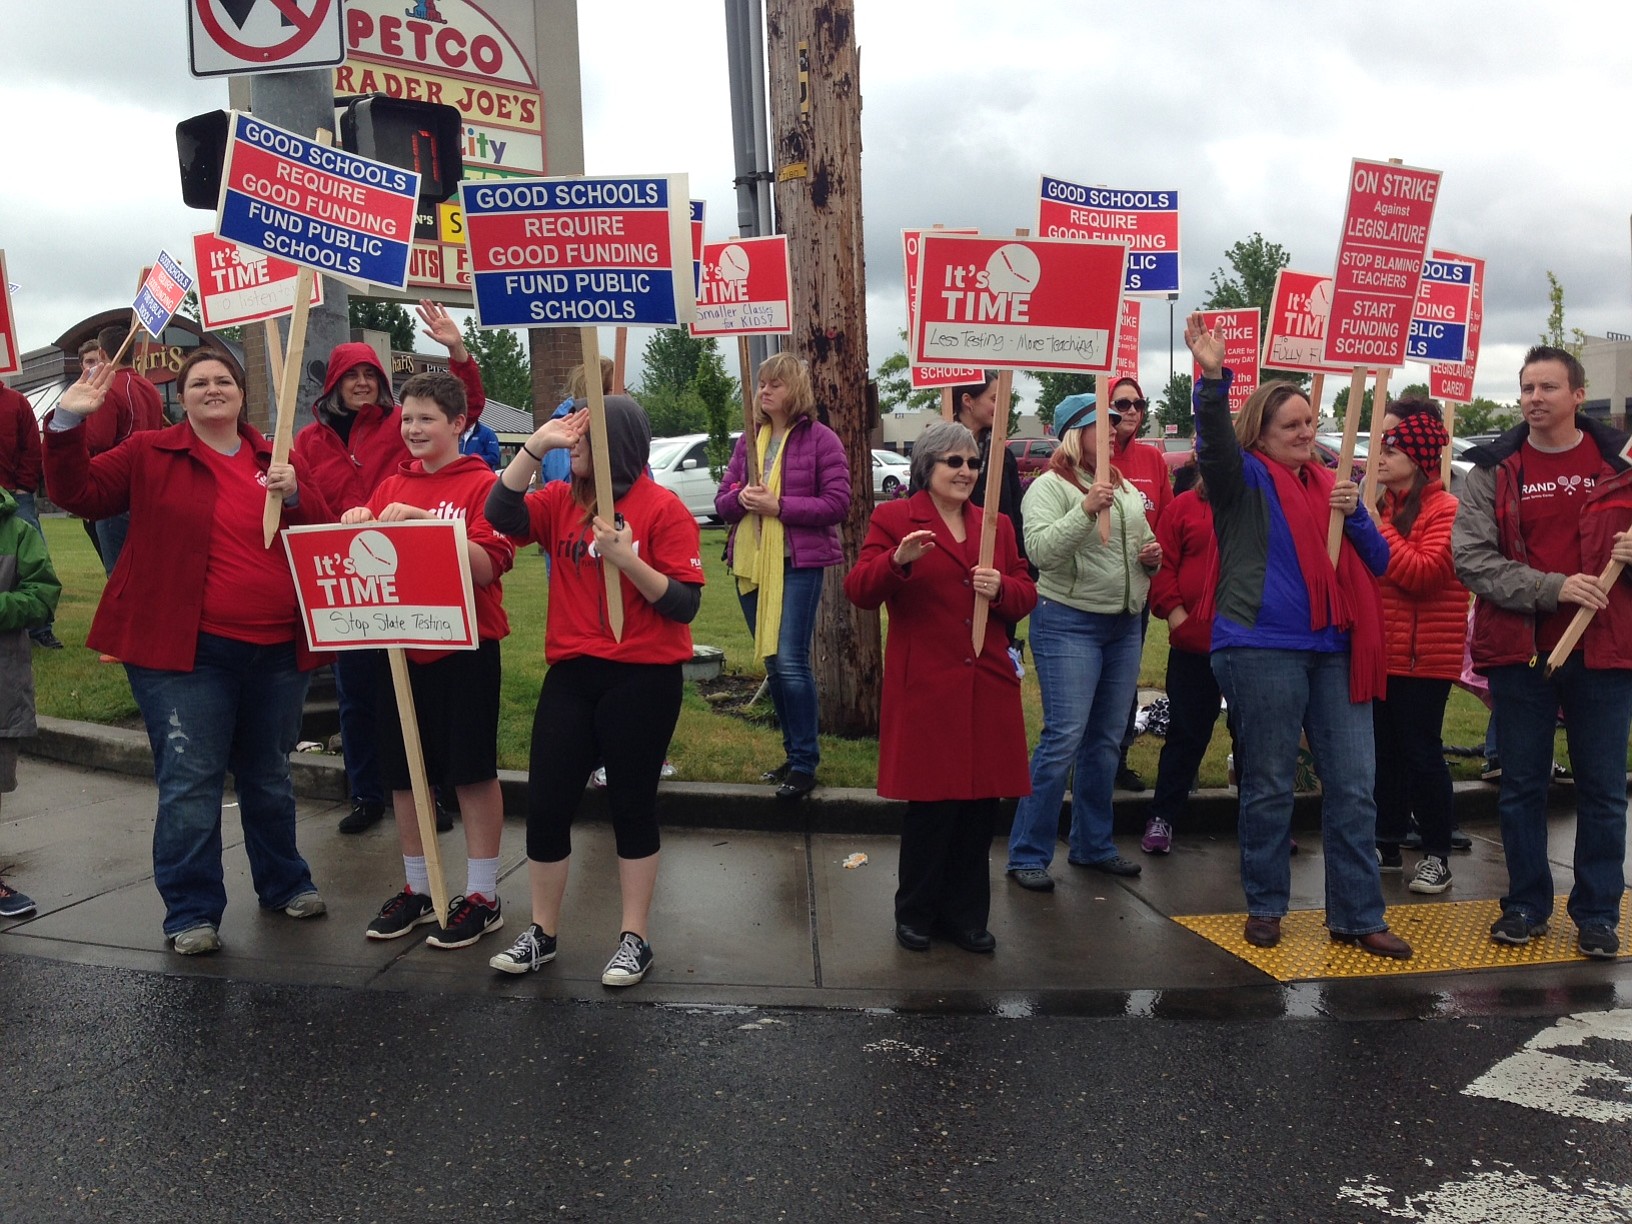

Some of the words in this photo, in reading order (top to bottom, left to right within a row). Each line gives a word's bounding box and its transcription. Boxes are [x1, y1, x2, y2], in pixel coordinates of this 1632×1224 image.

[347, 8, 503, 74] PETCO
[455, 87, 536, 123] JOE'S
[245, 123, 303, 158] GOOD
[308, 147, 406, 191] SCHOOLS
[461, 127, 506, 164] ity
[276, 161, 366, 206] REQUIRE
[1048, 181, 1085, 202] GOOD
[1090, 190, 1169, 208] SCHOOLS
[1354, 169, 1378, 194] ON
[1382, 173, 1436, 203] STRIKE
[242, 173, 300, 207] GOOD
[305, 195, 397, 235] FUNDING
[476, 186, 548, 209] GOOD
[555, 183, 658, 206] SCHOOLS
[1070, 209, 1138, 229] REQUIRE
[1374, 200, 1411, 217] Against
[248, 201, 303, 233] FUND
[308, 222, 383, 256] PUBLIC
[524, 216, 625, 237] REQUIRE
[1347, 216, 1425, 245] LEGISLATURE
[210, 247, 240, 268] It's
[262, 231, 361, 273] SCHOOLS
[488, 245, 559, 266] GOOD
[565, 243, 658, 264] FUNDING
[1127, 255, 1156, 269] LIC
[1341, 251, 1373, 267] STOP
[1374, 255, 1420, 273] BLAMING
[167, 263, 189, 288] SCHOOLS
[211, 259, 270, 292] TIME
[505, 274, 569, 295] FUND
[575, 273, 650, 293] PUBLIC
[945, 264, 990, 288] It's
[1352, 269, 1407, 289] TEACHERS
[700, 279, 749, 303] TIME
[1287, 292, 1312, 312] It's
[530, 299, 636, 320] SCHOOLS
[696, 305, 736, 320] Smaller
[743, 304, 773, 315] Classes
[941, 290, 1032, 323] TIME
[1353, 300, 1396, 319] START
[1416, 302, 1456, 319] DING
[740, 314, 773, 328] KIDS?
[1215, 315, 1237, 327] ON
[1340, 318, 1399, 338] FUNDING
[930, 328, 959, 347] Less
[961, 330, 1004, 351] Testing
[1017, 333, 1045, 351] More
[1227, 347, 1246, 355] CARE
[1246, 347, 1255, 355] for
[1335, 337, 1398, 357] SCHOOLS
[920, 367, 975, 380] SCHOOLS
[1238, 373, 1252, 382] the
[1441, 379, 1466, 396] CARED!
[313, 552, 357, 576] It's
[316, 575, 400, 606] TIME
[330, 611, 369, 637] Stop
[373, 612, 406, 631] State
[412, 613, 453, 641] Testing
